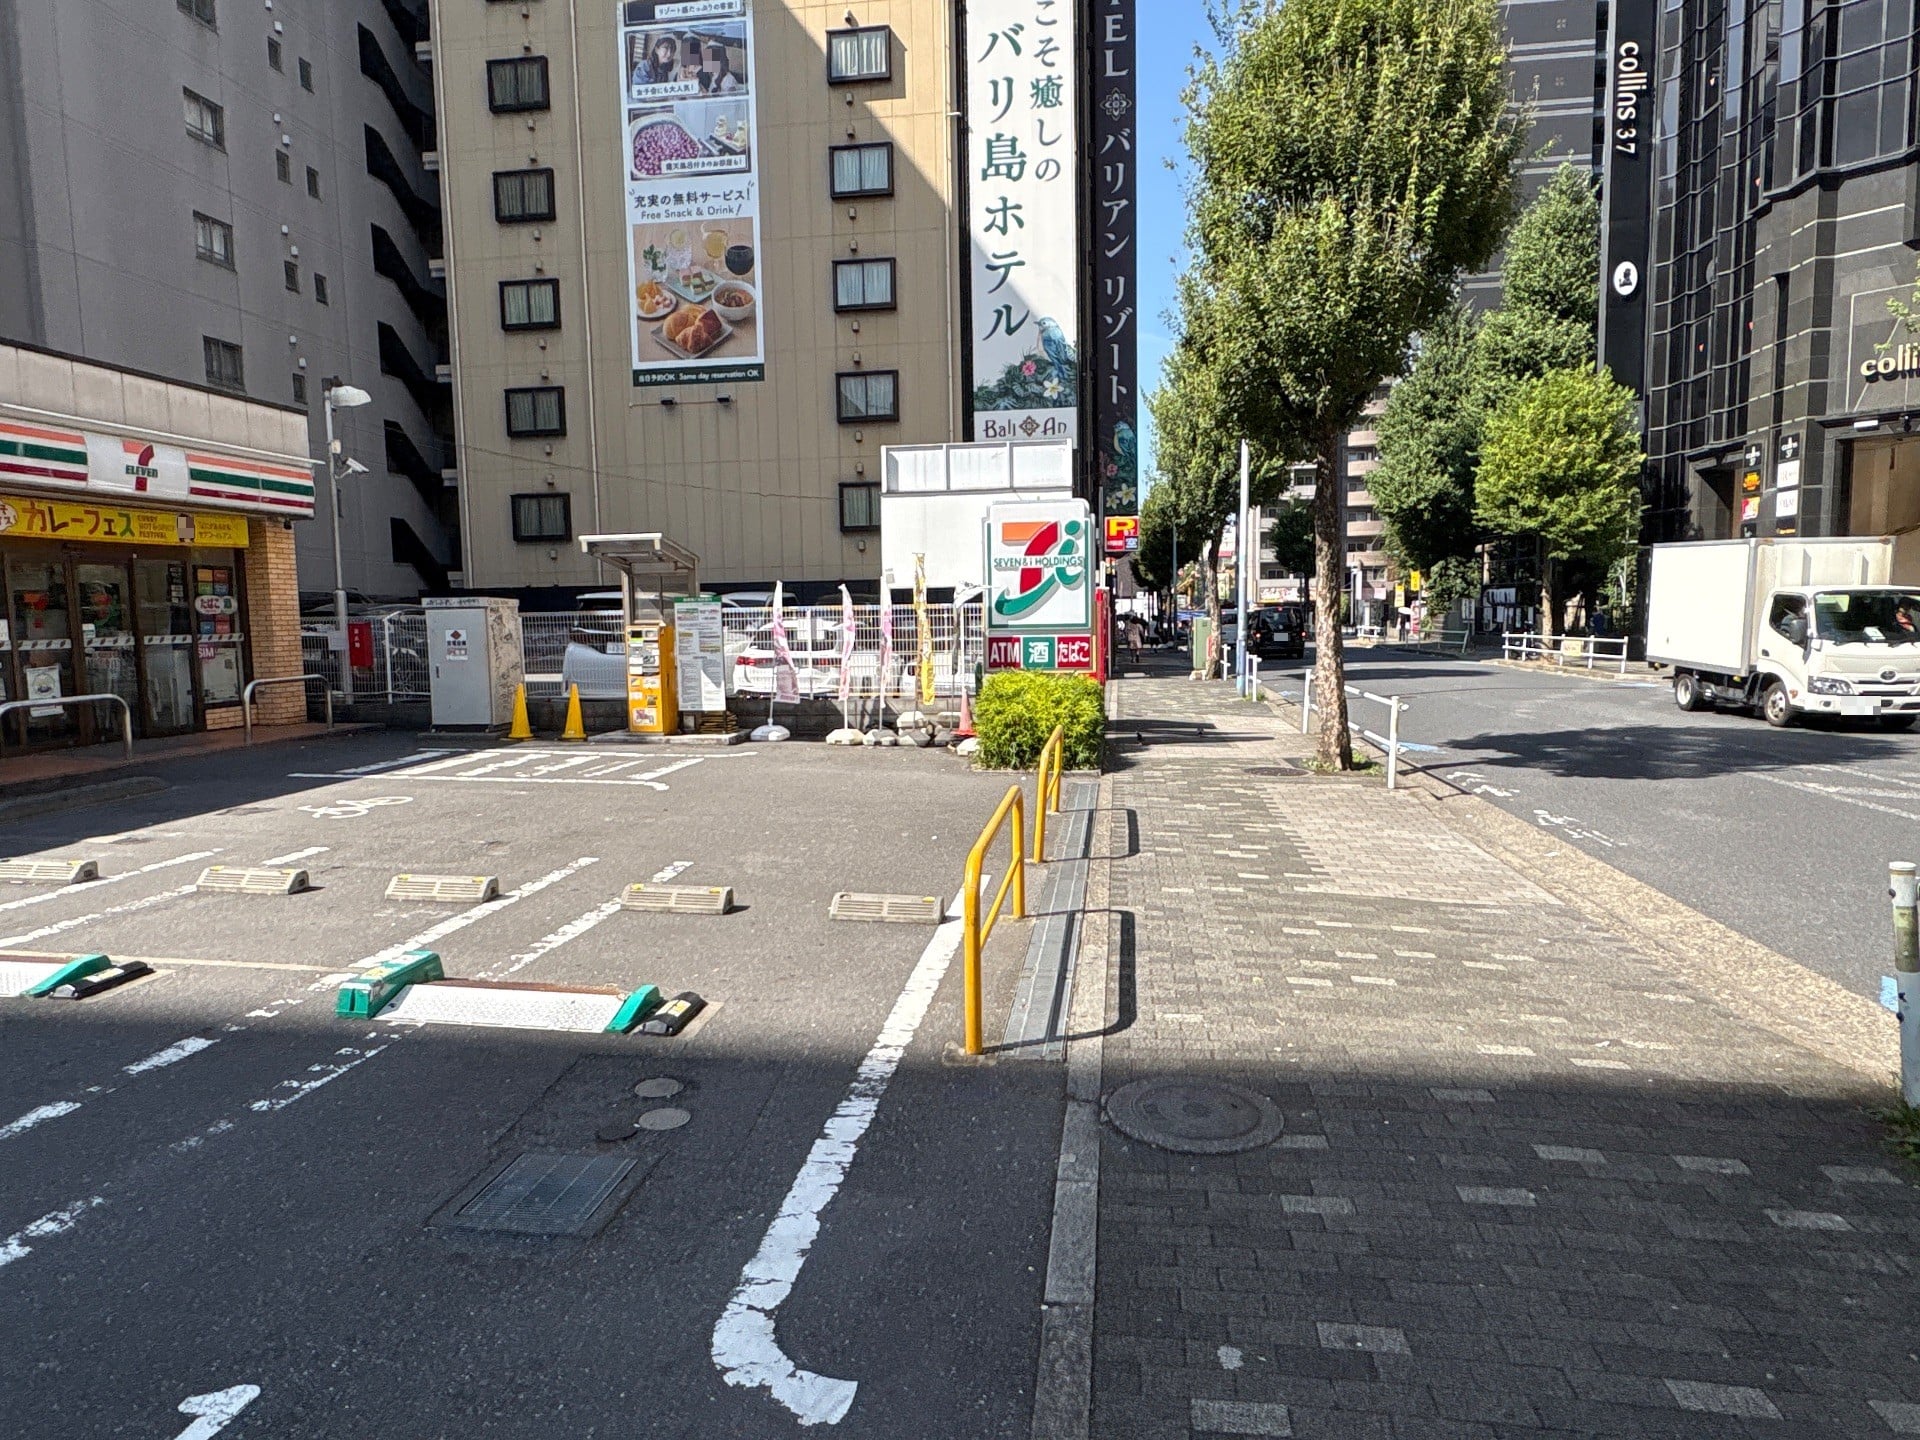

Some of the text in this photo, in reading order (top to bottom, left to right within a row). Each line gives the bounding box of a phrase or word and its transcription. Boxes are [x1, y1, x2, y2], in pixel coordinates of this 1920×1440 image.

[1103, 0, 1129, 77] EL
[1030, 0, 1064, 182] こそ癒しの
[1617, 41, 1648, 121] collins
[977, 22, 1030, 341] バリ島ホテル
[641, 210, 661, 220] Free
[664, 207, 693, 219] Snack
[696, 206, 704, 216] &
[1100, 127, 1134, 404] バリアン リゾート
[1860, 342, 1920, 376] colli
[679, 372, 697, 381] Same
[698, 372, 709, 380] day
[711, 369, 746, 379] reservation
[747, 369, 759, 377] OK
[22, 501, 136, 538] カレーフェス
[1109, 519, 1136, 537] P
[1035, 556, 1084, 568] HOLDINGS
[990, 642, 1020, 663] ATM
[1028, 641, 1049, 664] 酒
[1058, 641, 1090, 663] たばこ
